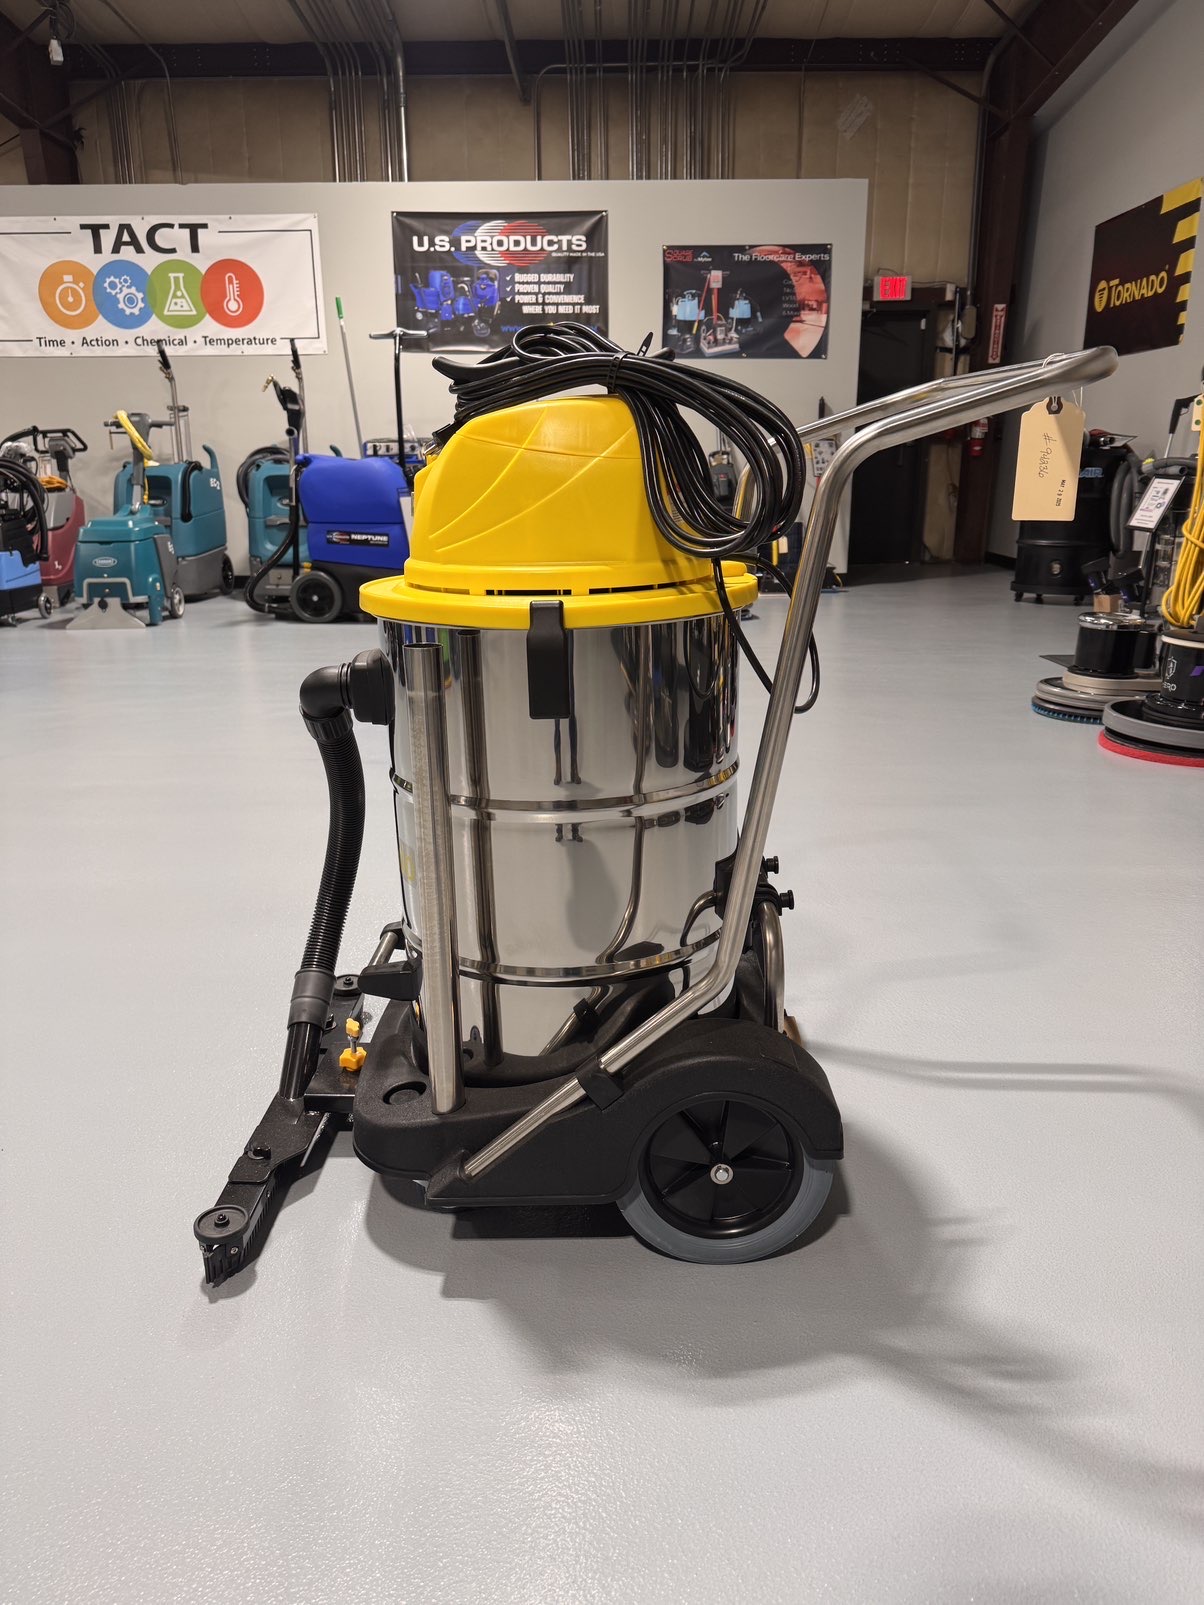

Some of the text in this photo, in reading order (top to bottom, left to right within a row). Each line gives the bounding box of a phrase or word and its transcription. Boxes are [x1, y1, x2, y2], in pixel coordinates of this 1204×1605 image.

[79, 222, 209, 255] TACT
[412, 235, 587, 252] U.S. PRODUCTS
[733, 252, 830, 262] The Floorcare Experts
[514, 273, 575, 282] RUGGED DURABILITY
[514, 284, 564, 293] PROVEN QUALITY
[880, 277, 907, 299] EXIT
[1109, 270, 1168, 308] TORNADO
[514, 294, 536, 303] POWER
[544, 294, 585, 303] CONVENIENCE
[522, 305, 600, 314] WHERE YOU NEED IT MOST
[36, 335, 278, 348] Time Action Chemical Temperature
